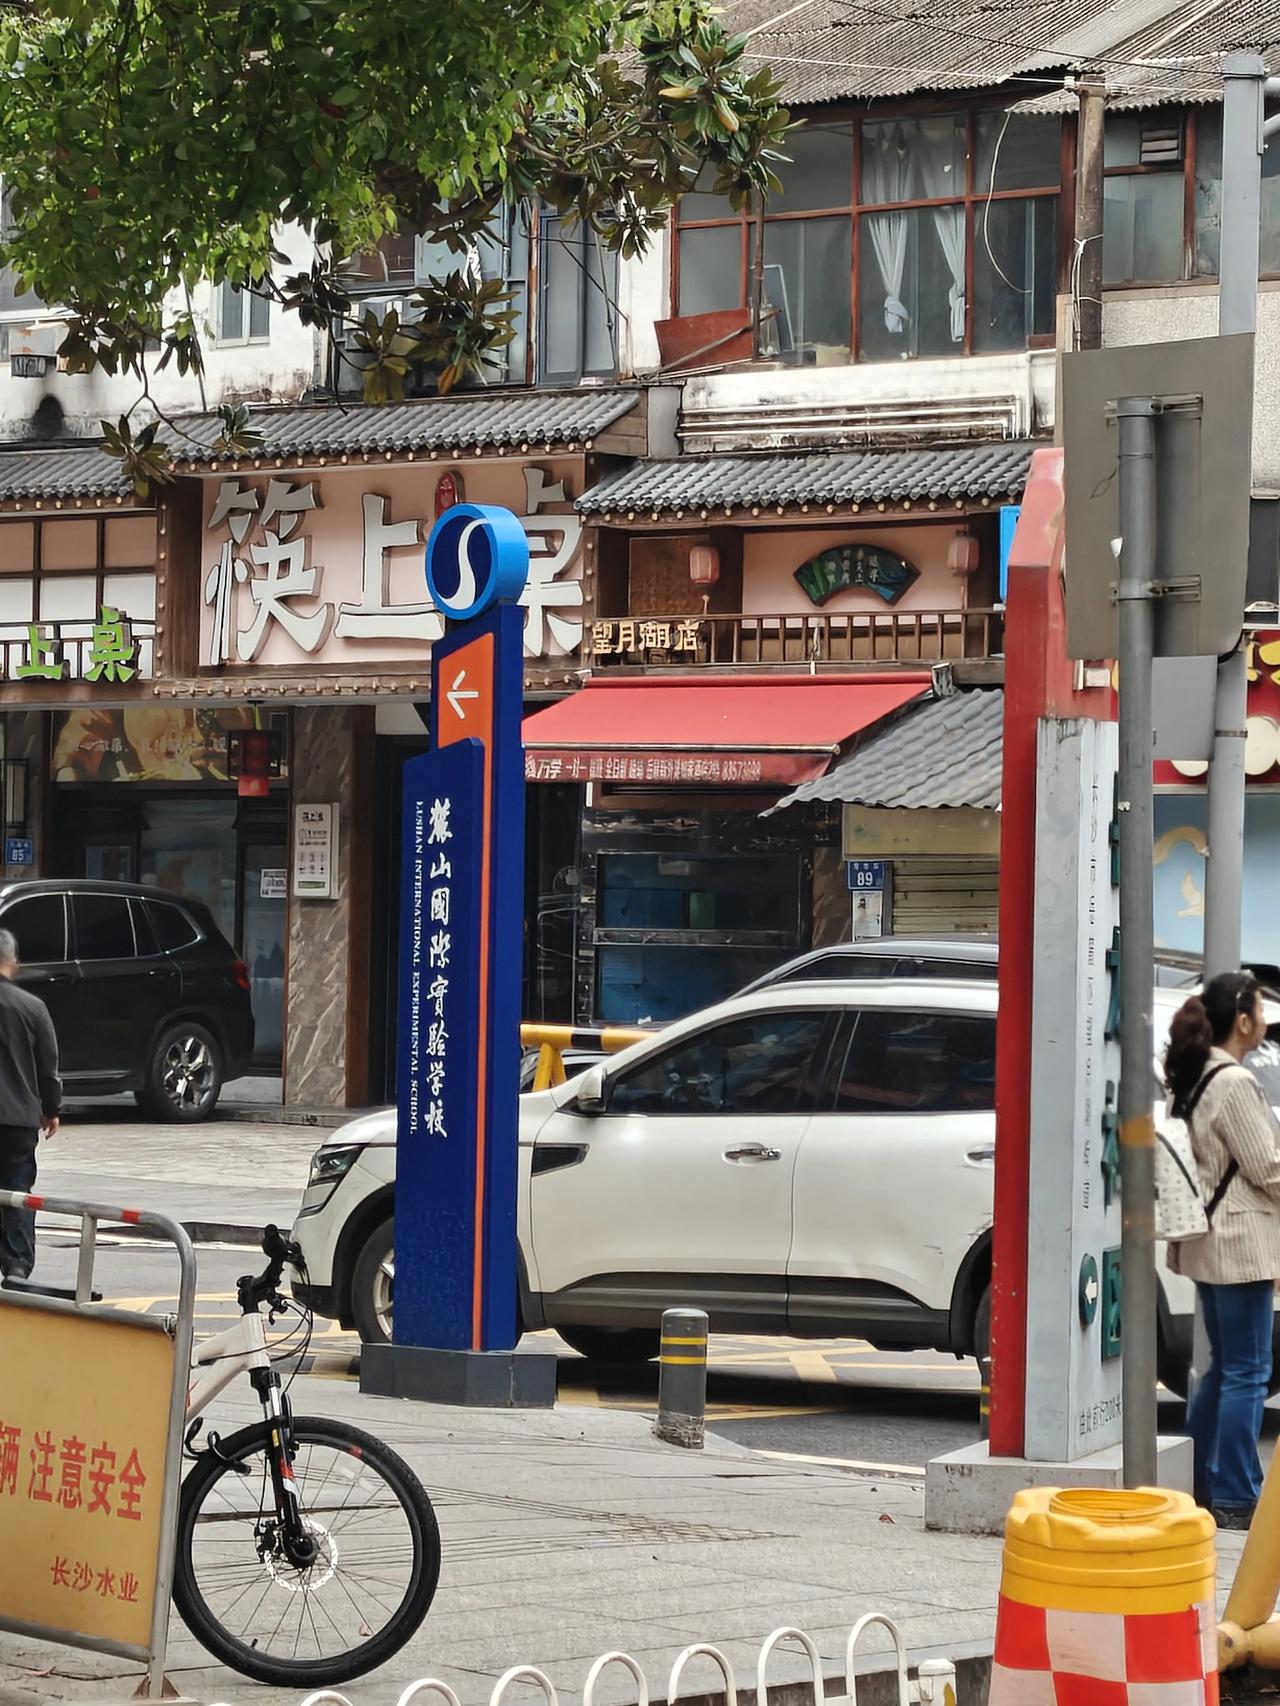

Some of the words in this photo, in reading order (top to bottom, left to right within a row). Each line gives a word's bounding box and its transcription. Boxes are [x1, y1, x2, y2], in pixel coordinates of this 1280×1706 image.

[204, 467, 584, 665] 筷上桌
[15, 604, 138, 684] 上桌
[591, 618, 703, 655] 望月湖店
[414, 800, 424, 854] LUSHAN
[857, 871, 874, 886] 89
[411, 859, 423, 967] INTERNATIONAL
[410, 971, 420, 1076] EXPERIMENTAL
[409, 1079, 419, 1135] SCHOOL
[28, 1429, 147, 1522] 注意安全
[50, 1555, 139, 1603] 长沙水业
